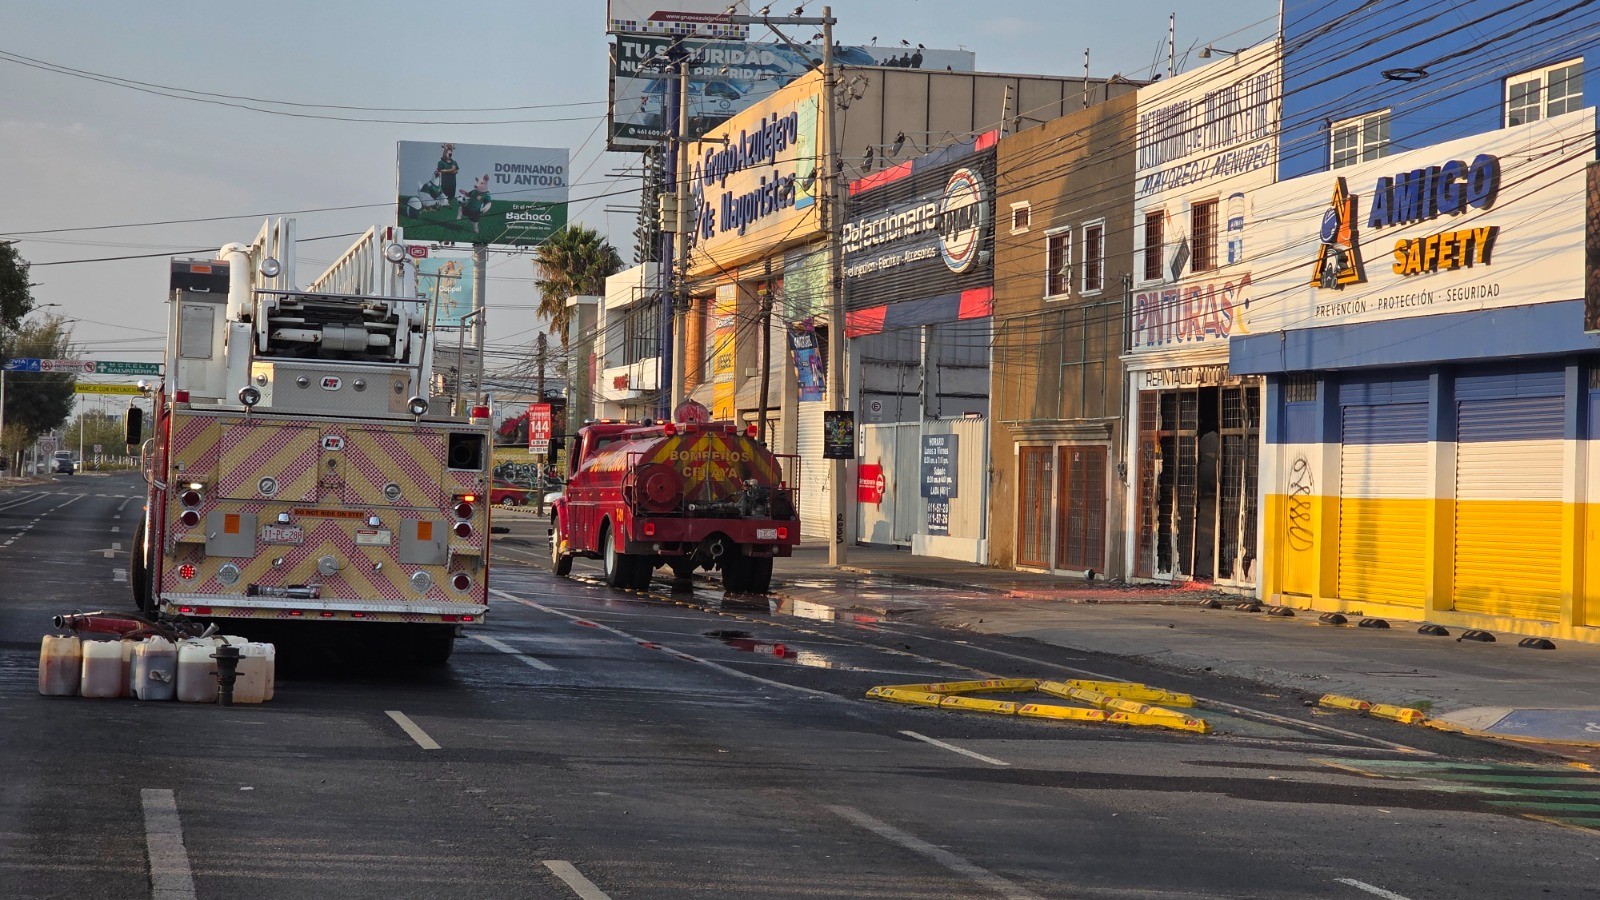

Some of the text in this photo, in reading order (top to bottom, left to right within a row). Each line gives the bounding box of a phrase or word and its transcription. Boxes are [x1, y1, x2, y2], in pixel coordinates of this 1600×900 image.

[621, 41, 776, 66] TU SGURIDAD
[703, 111, 798, 189] Grupo Azulejero
[494, 162, 564, 175] DOMINANDO
[494, 173, 511, 185] TU
[1140, 161, 1199, 195] MAYOREO
[1210, 143, 1271, 179] MENUDEO
[1367, 153, 1501, 230] AMIGO
[701, 169, 796, 240] de Mayoristas
[505, 211, 552, 221] Bachoco
[841, 201, 937, 254] Refaccionaria
[1391, 225, 1501, 277] SAFETY
[438, 285, 462, 293] Coppel
[1315, 282, 1500, 317] PREVENCIÓN PROTECCIÓN SEGURIDAD
[1134, 281, 1235, 347] PINTURAS
[1145, 367, 1194, 387] REPINTADO
[77, 385, 97, 393] MANEJE
[98, 385, 109, 393] CON
[530, 420, 549, 433] 144
[669, 450, 750, 462] BOMBEROS
[682, 466, 738, 479] CELAYA
